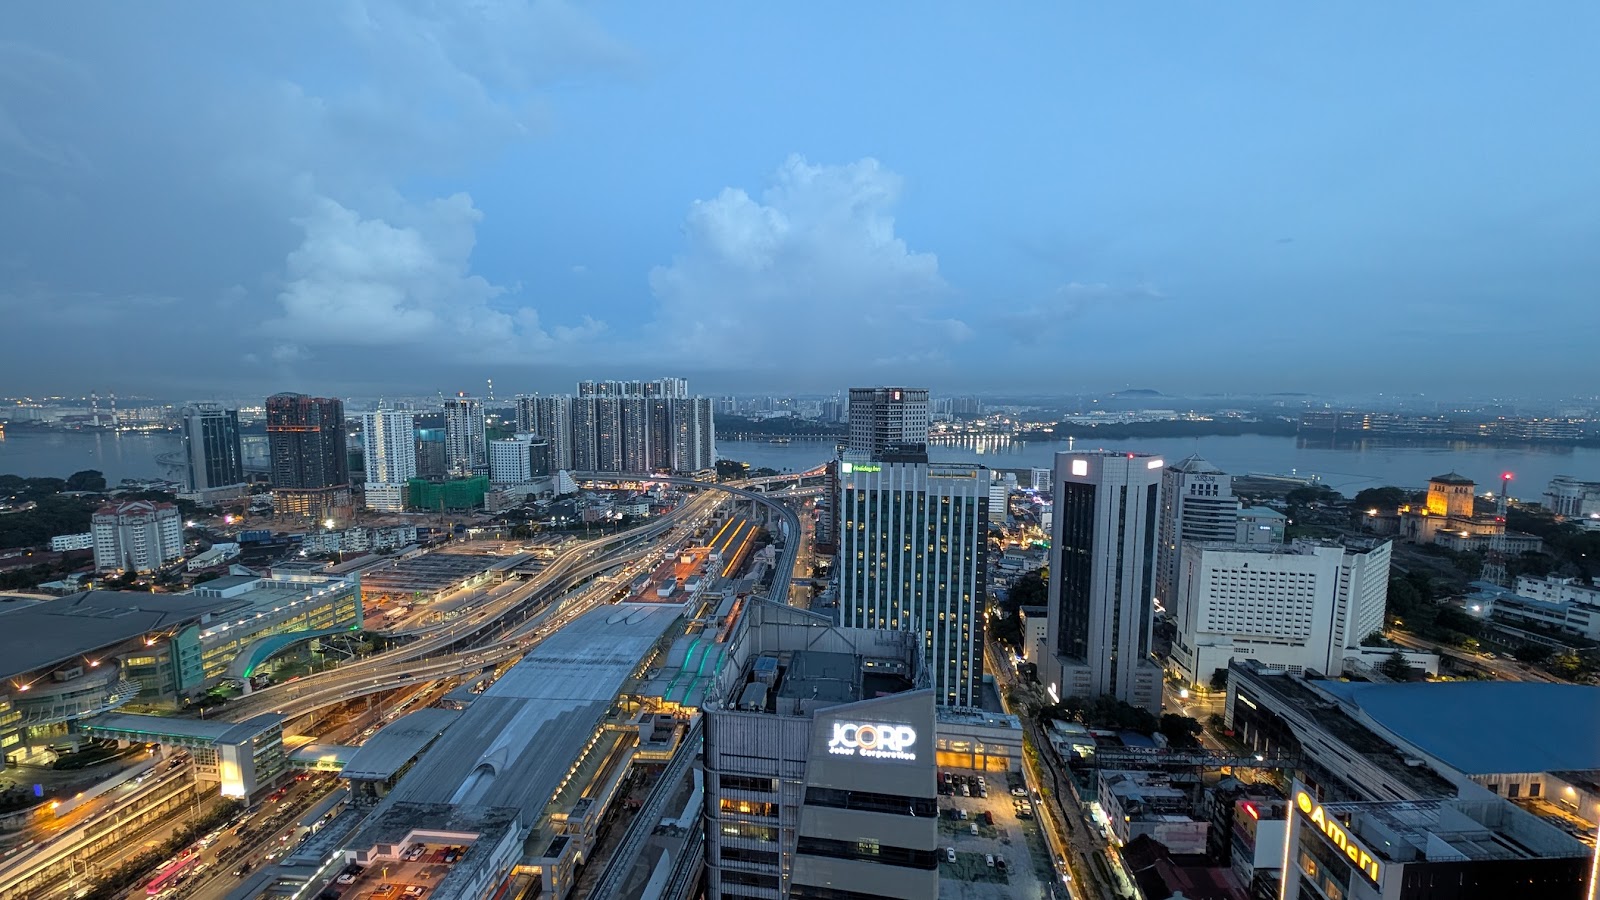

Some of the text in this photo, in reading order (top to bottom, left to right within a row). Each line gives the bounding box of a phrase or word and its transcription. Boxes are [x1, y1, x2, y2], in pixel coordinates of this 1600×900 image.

[853, 465, 872, 473] Holiday
[829, 723, 916, 750] JCORP
[828, 746, 916, 760] Johor Corporation
[1311, 805, 1379, 881] Amari
